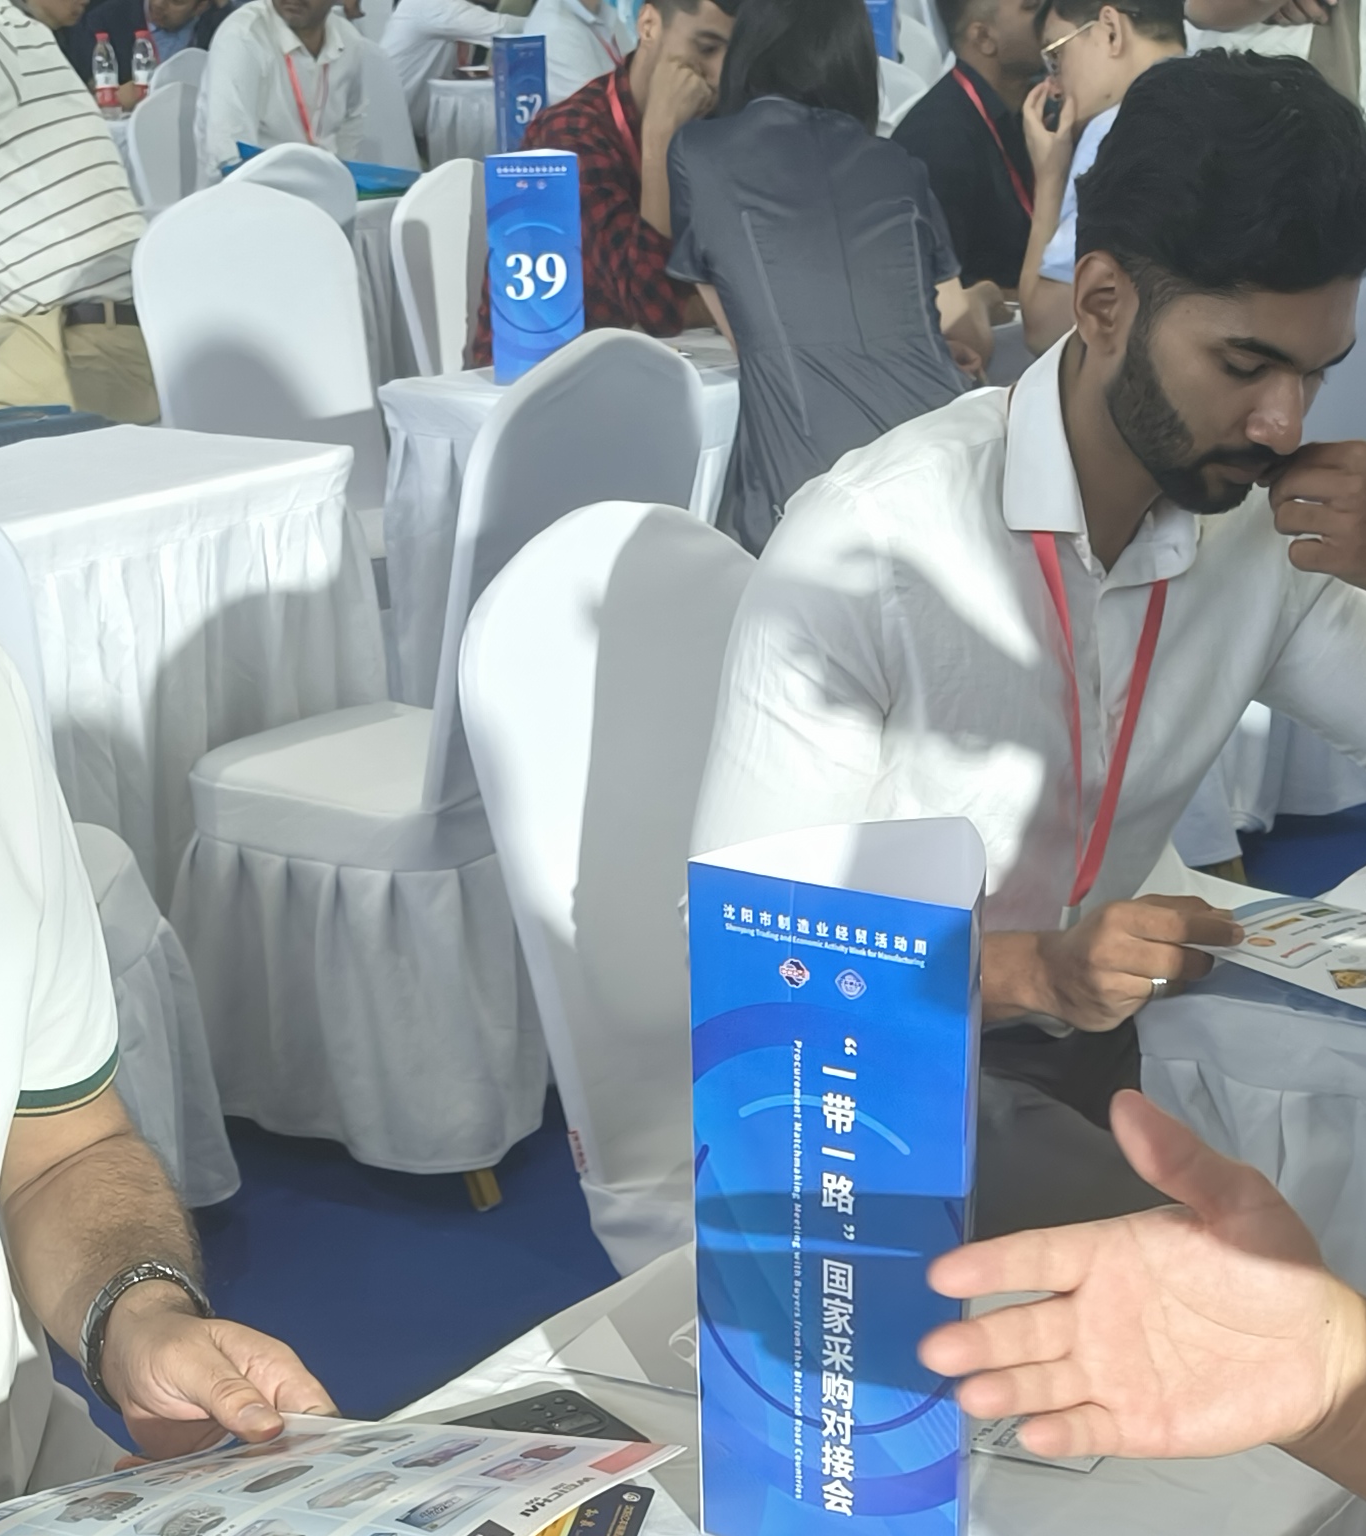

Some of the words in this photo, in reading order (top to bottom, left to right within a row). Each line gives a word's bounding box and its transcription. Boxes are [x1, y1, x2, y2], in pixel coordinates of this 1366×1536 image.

[505, 252, 568, 301] 39
[722, 903, 927, 956] 沈阳市制造业经贸活动周
[792, 1040, 803, 1119] Procurement
[792, 1121, 803, 1200] Matchmaking
[792, 1203, 803, 1248] Meeting
[792, 1251, 803, 1276] with
[792, 1280, 803, 1318] Buyers
[792, 1320, 803, 1346] from
[792, 1350, 803, 1368] the
[792, 1370, 803, 1393] Belt
[792, 1396, 803, 1416] and
[792, 1419, 803, 1445] Road
[792, 1448, 803, 1499] Countries
